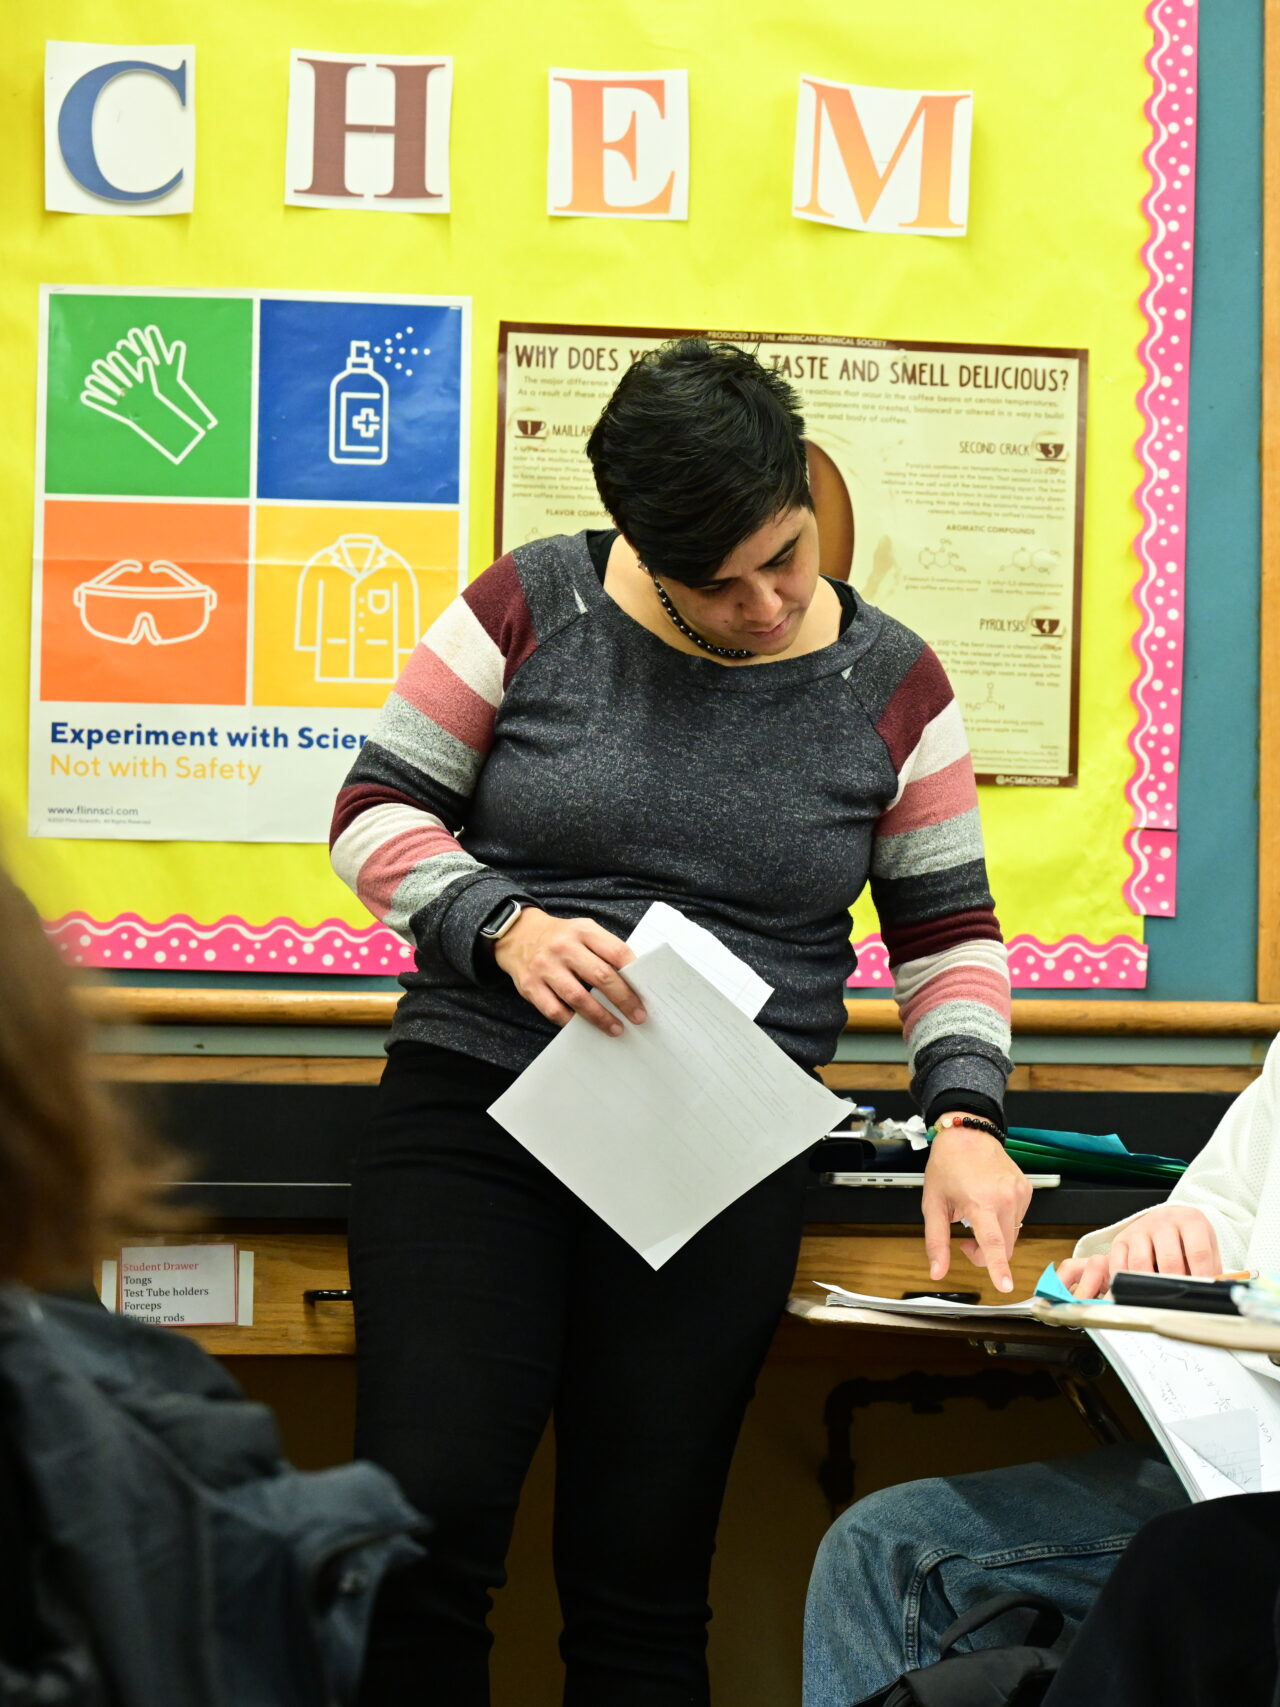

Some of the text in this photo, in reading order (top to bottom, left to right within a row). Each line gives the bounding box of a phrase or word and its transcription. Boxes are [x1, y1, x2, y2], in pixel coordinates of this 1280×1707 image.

[58, 57, 971, 229] CHEM
[708, 331, 887, 347] PRODUCED BY THE AMERICAN CHEMICAL SOCIETY
[515, 344, 559, 369] WHY
[568, 346, 619, 371] DOES
[769, 355, 829, 380] TASTE
[839, 359, 880, 383] AND
[889, 361, 950, 387] SMELL
[959, 365, 1070, 392] DELICIOUS?
[518, 388, 527, 396] As
[538, 389, 560, 397] result
[562, 389, 571, 397] of
[524, 375, 537, 384] The
[908, 393, 934, 401] coffee
[552, 424, 594, 438] MAILLAR
[959, 441, 996, 455] SECOND
[1000, 442, 1030, 456] CRACK
[545, 508, 612, 518] FLAVOR COMPOU
[946, 524, 1035, 535] AROMATIC COMPOUNDS
[979, 618, 1026, 633] PYROLYSIS
[50, 721, 218, 750] Experiment
[227, 725, 289, 749] with
[50, 754, 262, 786] Not with Safety
[48, 805, 139, 816] www.flinnsci.com
[124, 1262, 200, 1273] Student Drawer
[124, 1276, 152, 1287] Tongs
[124, 1287, 209, 1298] Test Tube holders
[124, 1301, 162, 1312] Forceps
[163, 1313, 185, 1323] rods
